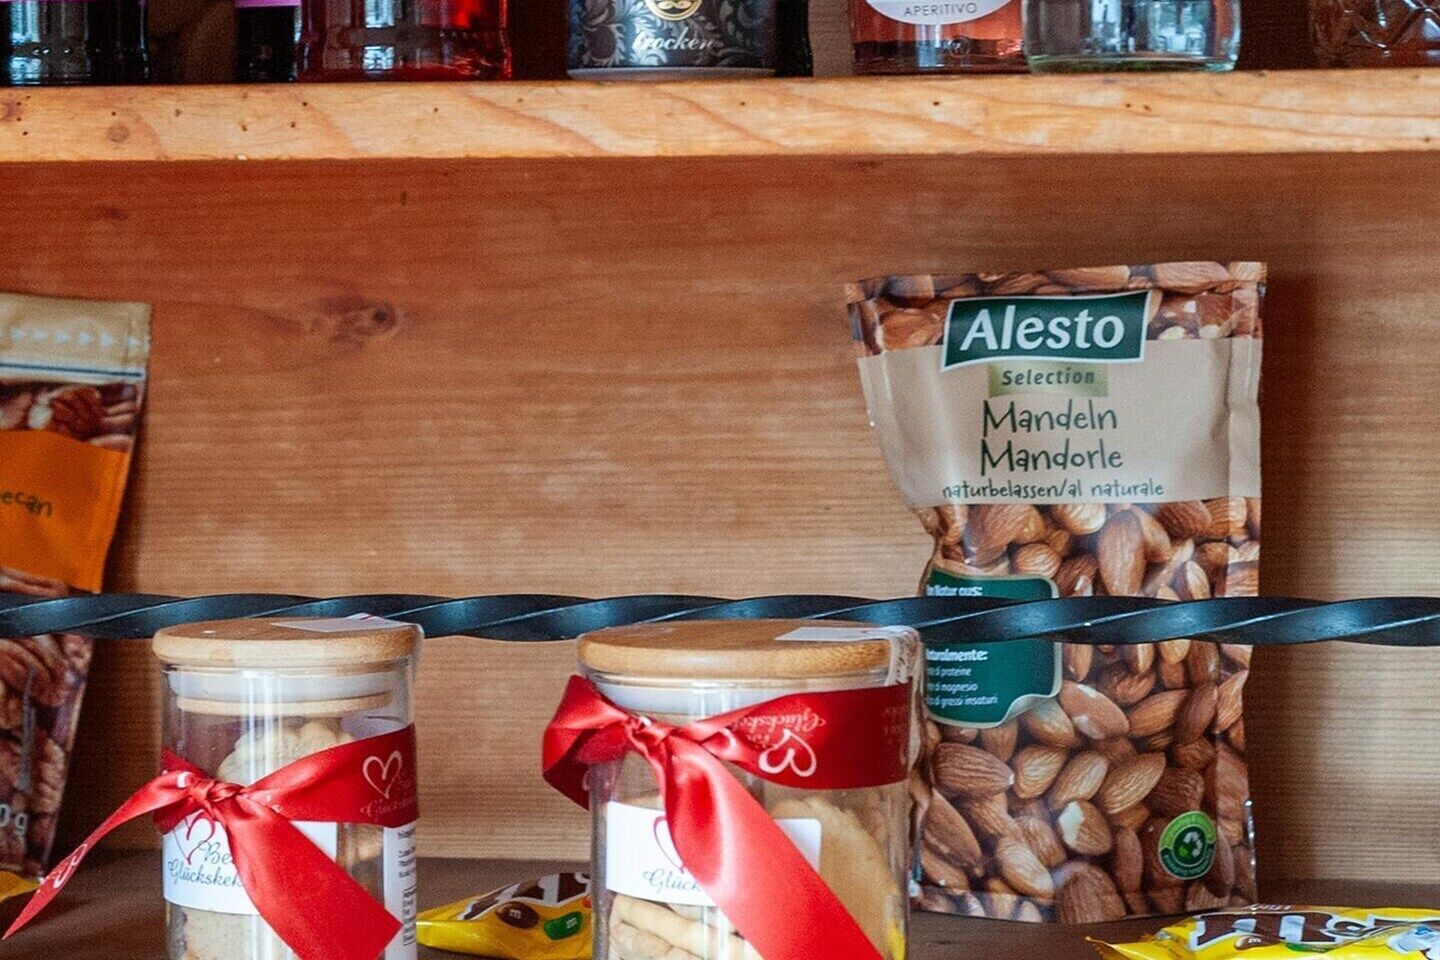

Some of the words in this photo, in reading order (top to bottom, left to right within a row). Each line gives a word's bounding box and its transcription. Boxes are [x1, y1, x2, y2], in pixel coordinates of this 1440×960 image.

[903, 2, 978, 17] APERITIVO
[959, 305, 1126, 352] Alesto
[1001, 368, 1096, 386] Selection
[982, 399, 1118, 438] Mandeln
[980, 439, 1124, 477] Mandorle
[942, 478, 1083, 499] naturbelassen/al
[1091, 478, 1164, 497] naturale
